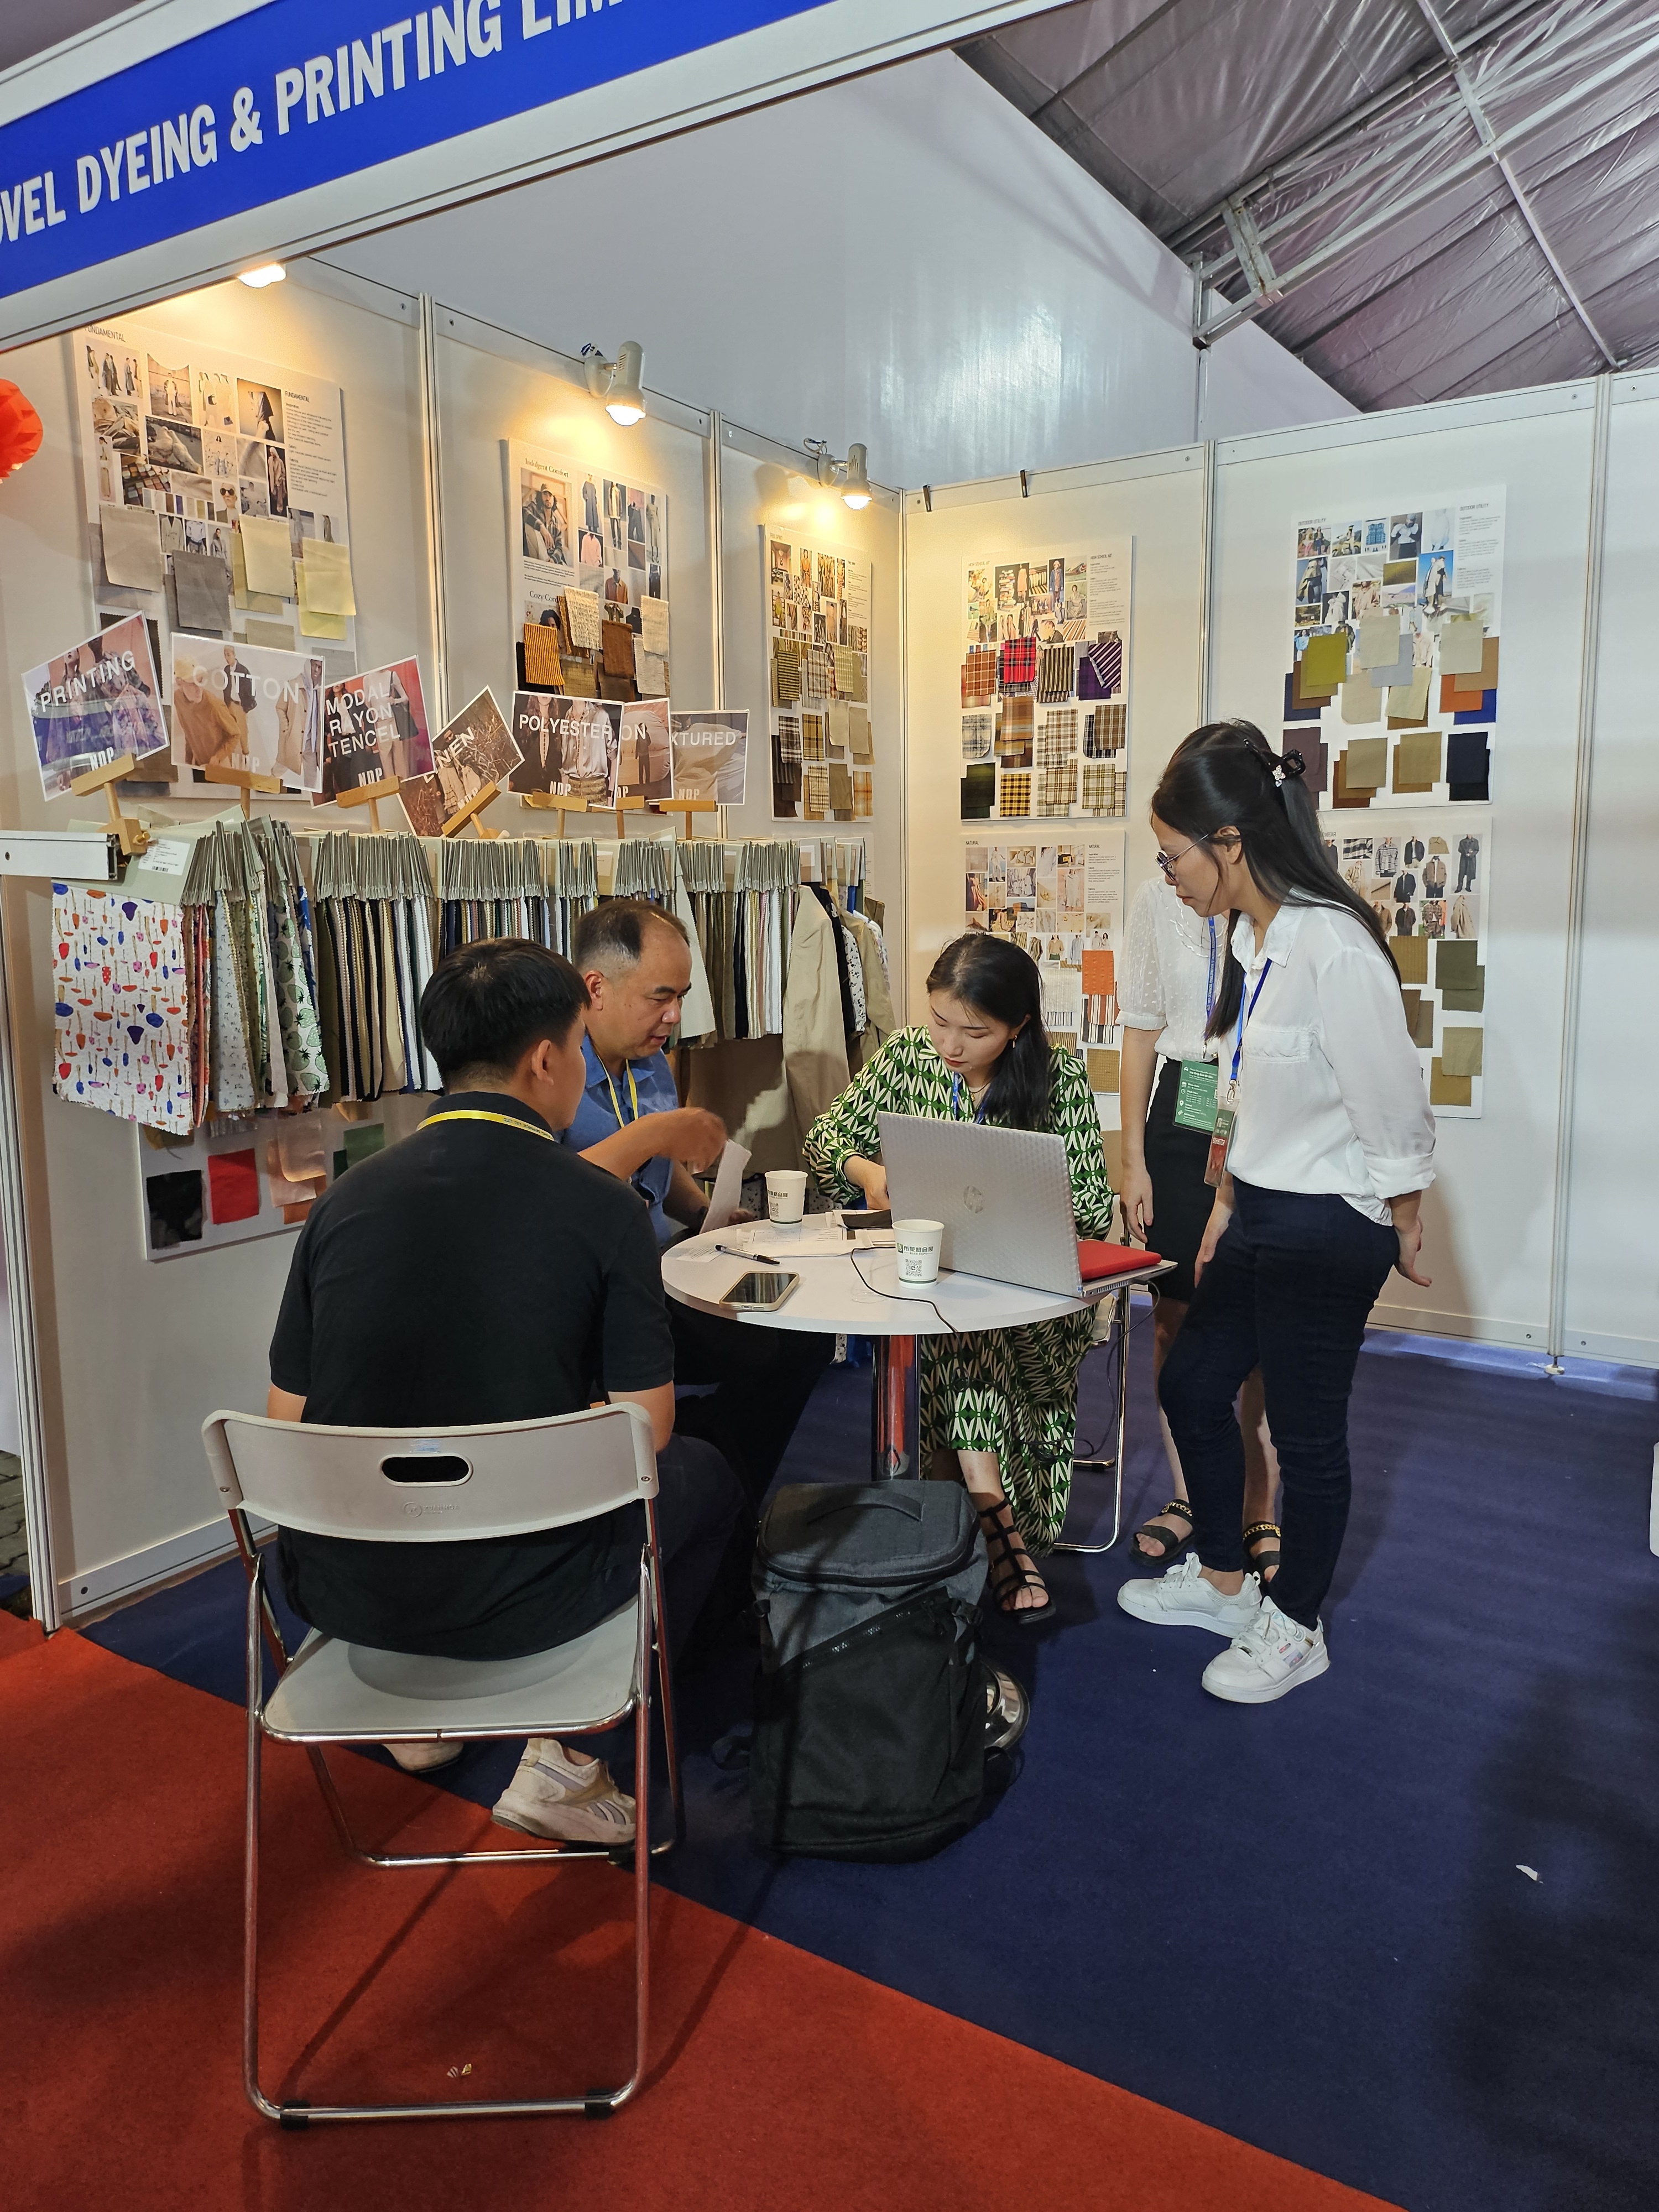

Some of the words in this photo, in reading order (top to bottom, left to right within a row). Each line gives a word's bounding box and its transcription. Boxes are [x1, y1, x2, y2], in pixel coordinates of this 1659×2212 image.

[0, 170, 66, 244] VEL
[77, 112, 218, 215] DYEING
[229, 87, 263, 153] &
[275, 0, 503, 135] PRINTING
[285, 390, 310, 403] FUNDAMENTAL
[525, 458, 547, 471] Indulgent
[549, 466, 568, 478] Comfort
[529, 590, 544, 602] Cozy
[40, 650, 136, 713] PRINTING
[192, 665, 301, 705] COTTON
[325, 682, 390, 716] MODAL
[329, 702, 394, 737] RAYON
[519, 714, 612, 741] POLYESTER
[330, 723, 401, 759] TENCEL
[231, 753, 260, 773] NDP
[358, 767, 383, 787] NDP
[549, 781, 572, 796] NDP
